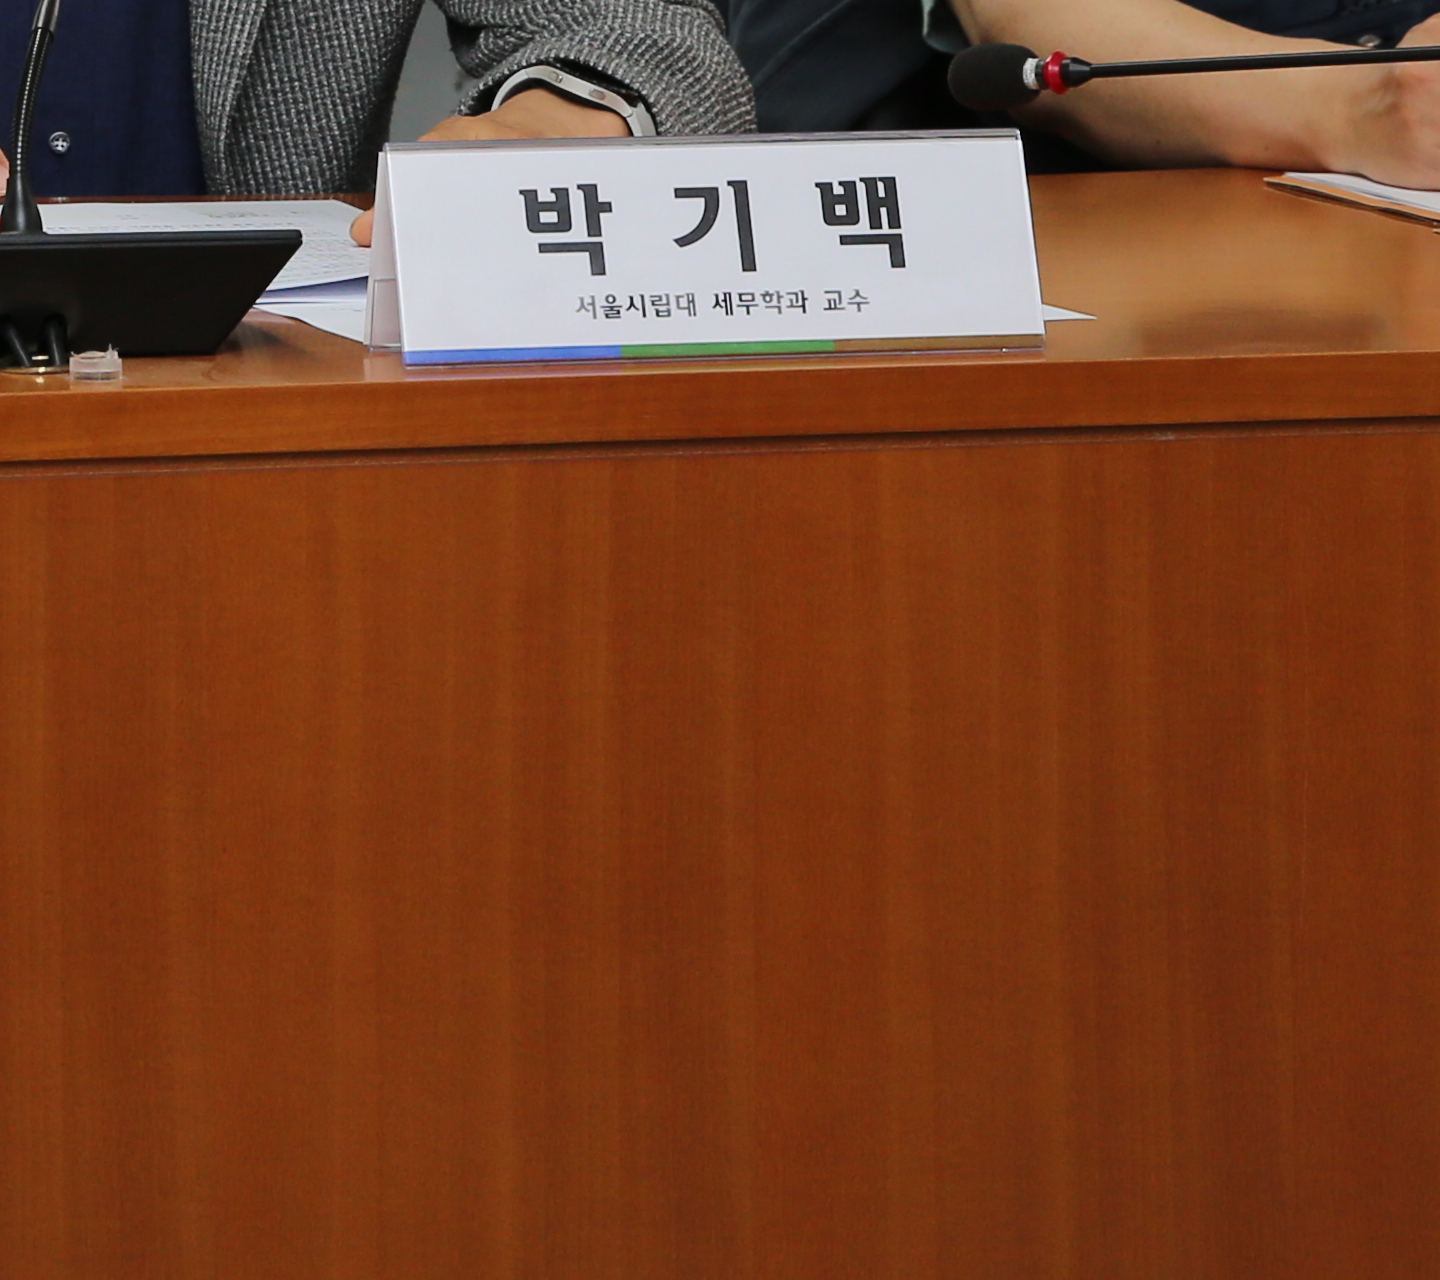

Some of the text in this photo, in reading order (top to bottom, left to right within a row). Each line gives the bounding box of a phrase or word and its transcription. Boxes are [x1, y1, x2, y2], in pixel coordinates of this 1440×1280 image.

[576, 288, 871, 320] 서울시립대 세무학과 교수
